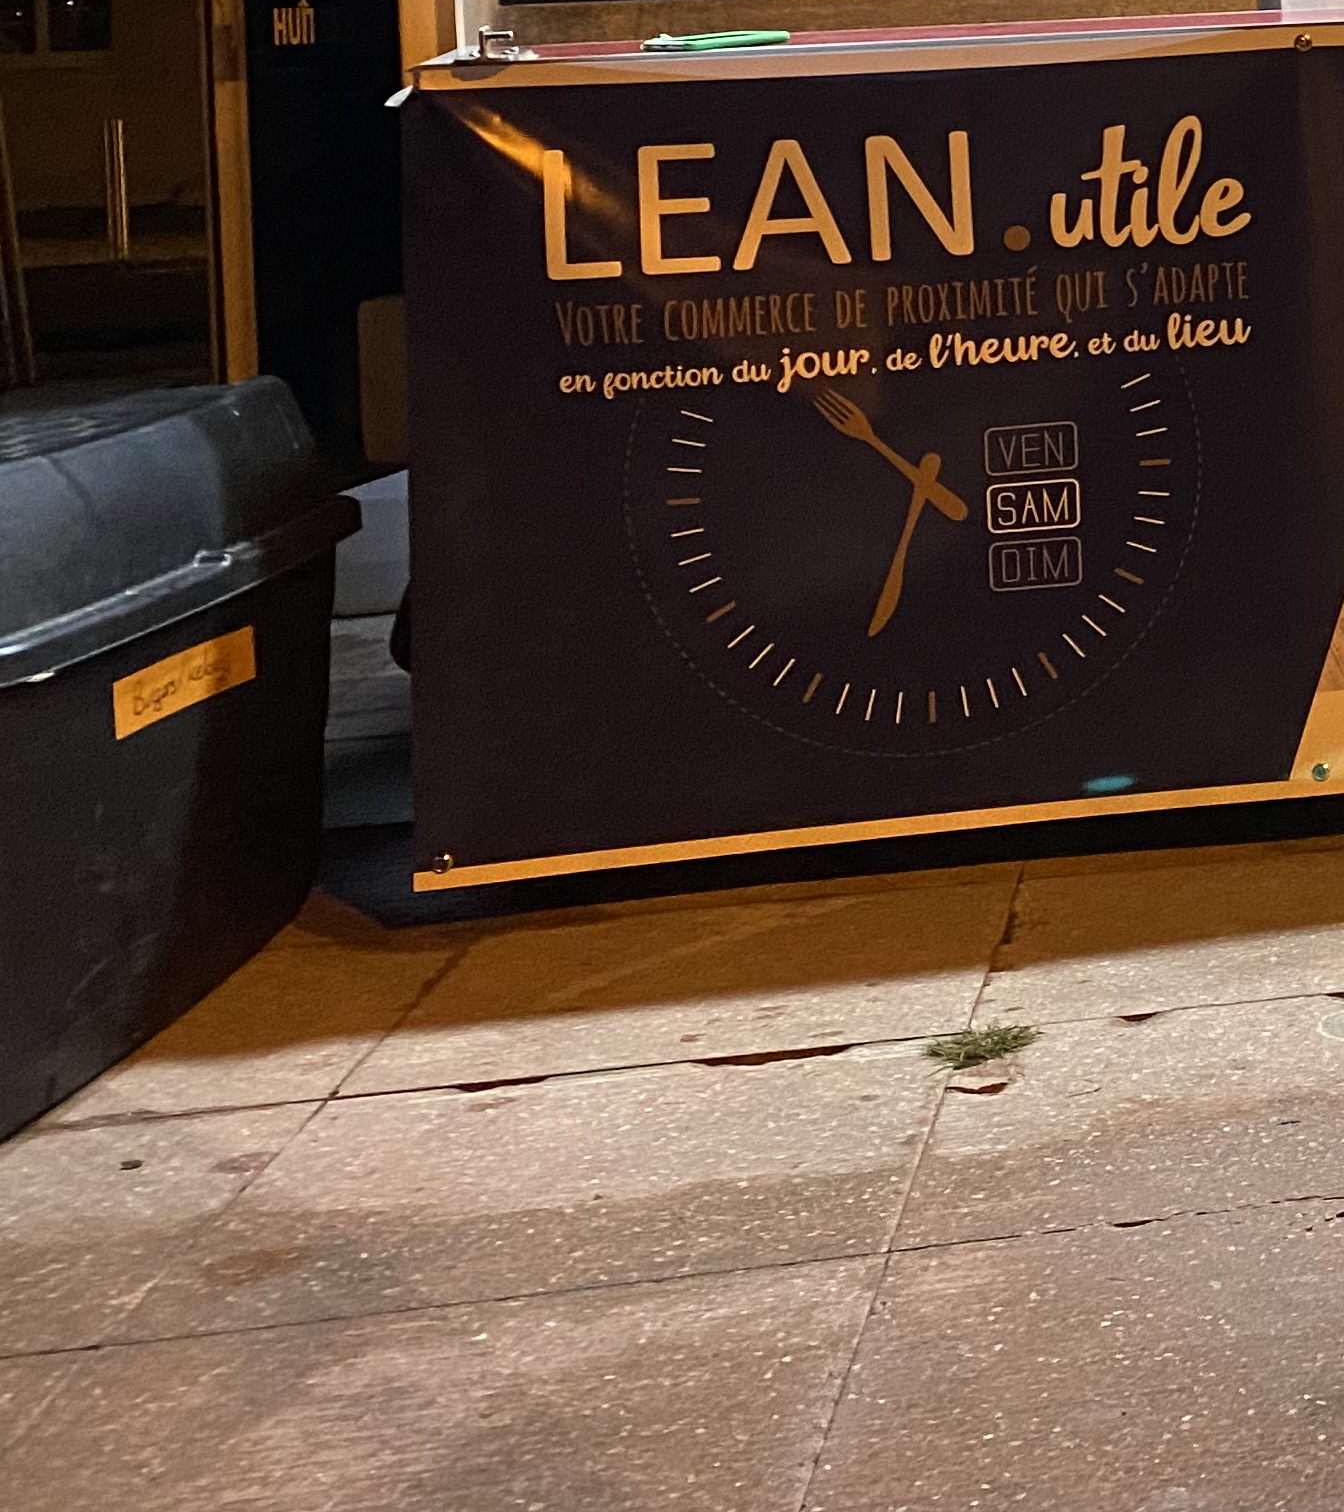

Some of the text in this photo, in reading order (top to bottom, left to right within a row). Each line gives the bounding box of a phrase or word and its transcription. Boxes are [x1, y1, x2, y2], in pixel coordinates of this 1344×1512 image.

[555, 261, 1250, 347] VOTRE COMMERCE DE PROXIMITÉ QUI S'ADAPTE
[558, 372, 597, 394] en
[602, 364, 724, 400] fonction
[731, 359, 772, 384] du
[885, 348, 923, 372] de
[1087, 331, 1117, 356] et
[1122, 329, 1161, 353] du
[1166, 311, 1252, 351] lieu
[997, 429, 1066, 470] VEN
[997, 488, 1071, 525] SAM
[1001, 545, 1072, 584] DIM
